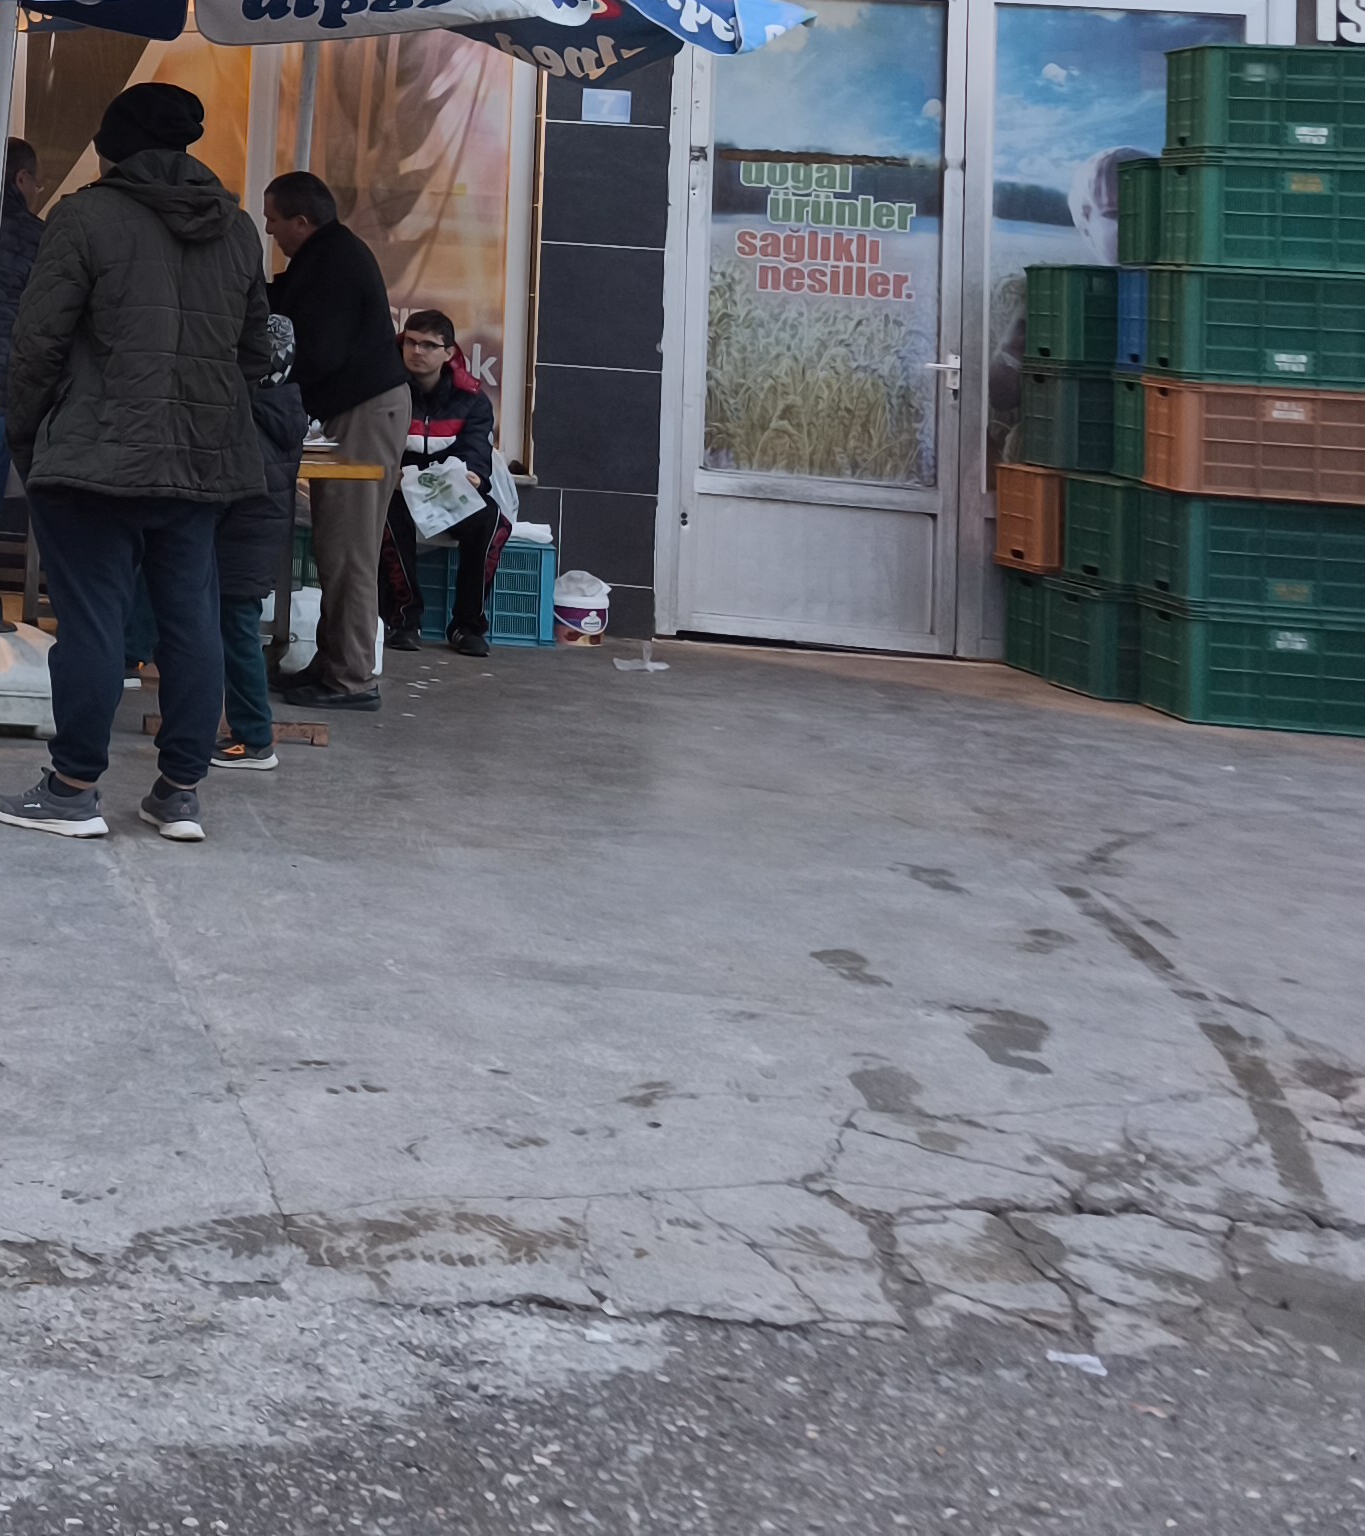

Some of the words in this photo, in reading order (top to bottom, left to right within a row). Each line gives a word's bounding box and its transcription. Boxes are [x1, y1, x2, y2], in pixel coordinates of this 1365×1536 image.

[767, 191, 916, 232] ürünler
[735, 228, 881, 265] sağlıklı
[757, 264, 915, 302] nesiller.
